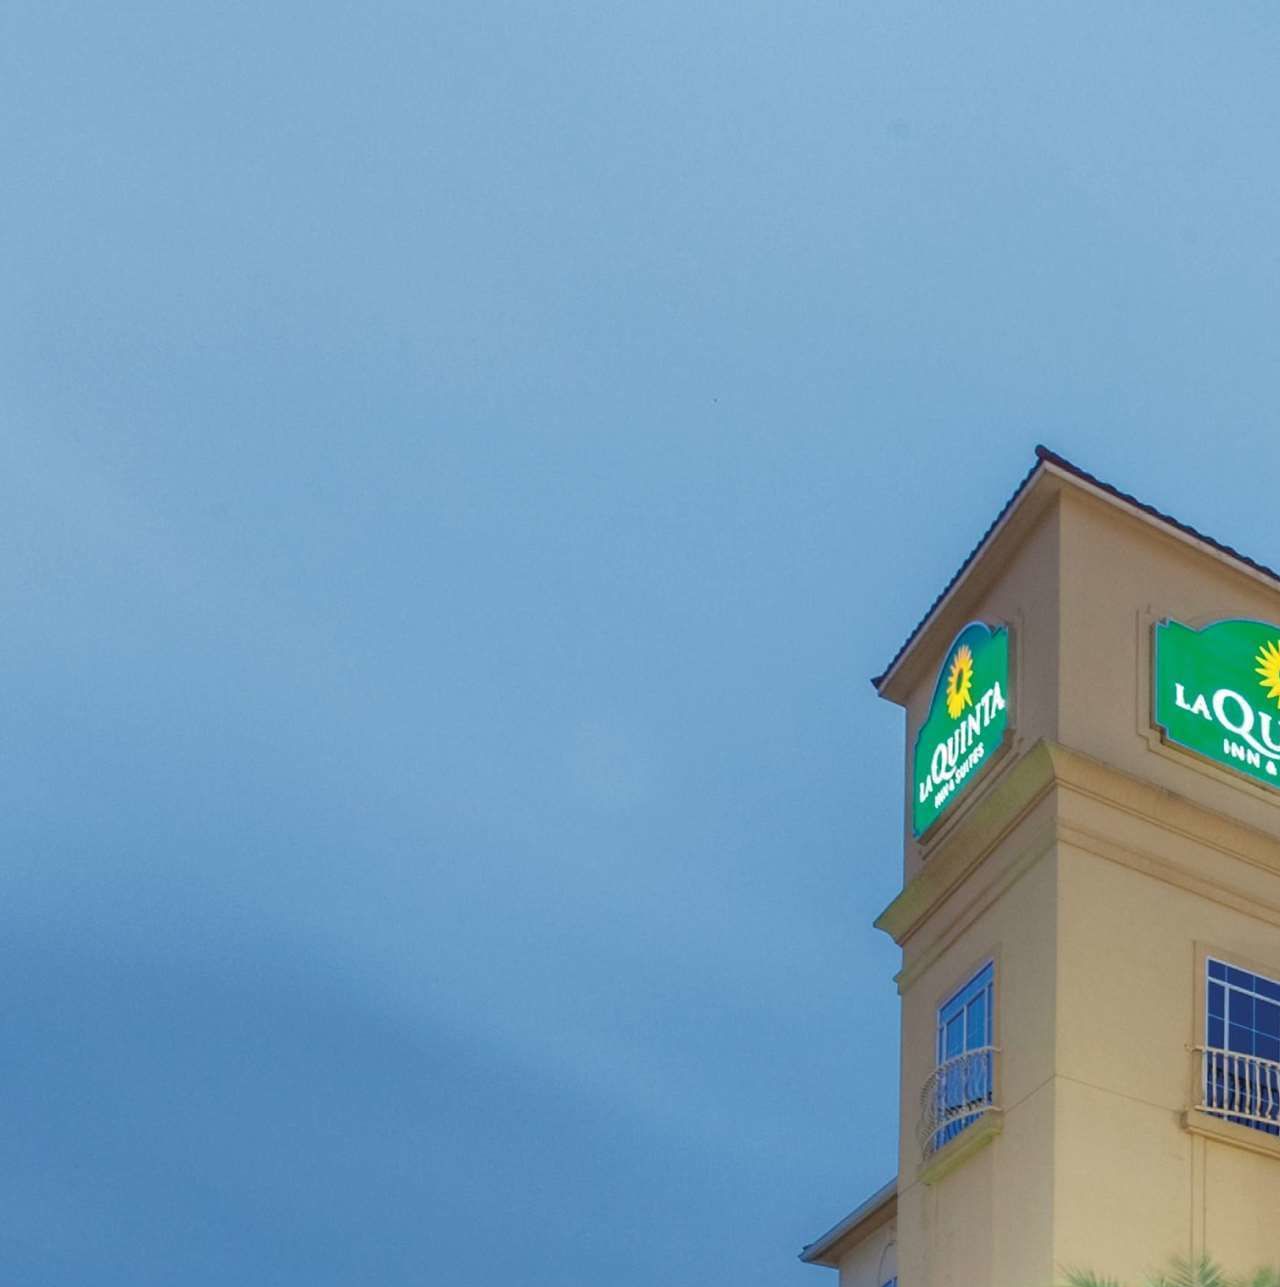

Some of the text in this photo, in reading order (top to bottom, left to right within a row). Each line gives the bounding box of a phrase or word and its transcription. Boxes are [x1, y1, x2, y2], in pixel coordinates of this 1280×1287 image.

[1175, 682, 1213, 721] LA
[919, 681, 1006, 803] LA QUINTA
[1223, 738, 1261, 769] INN
[1265, 761, 1278, 776] &
[955, 742, 985, 785] SUITES
